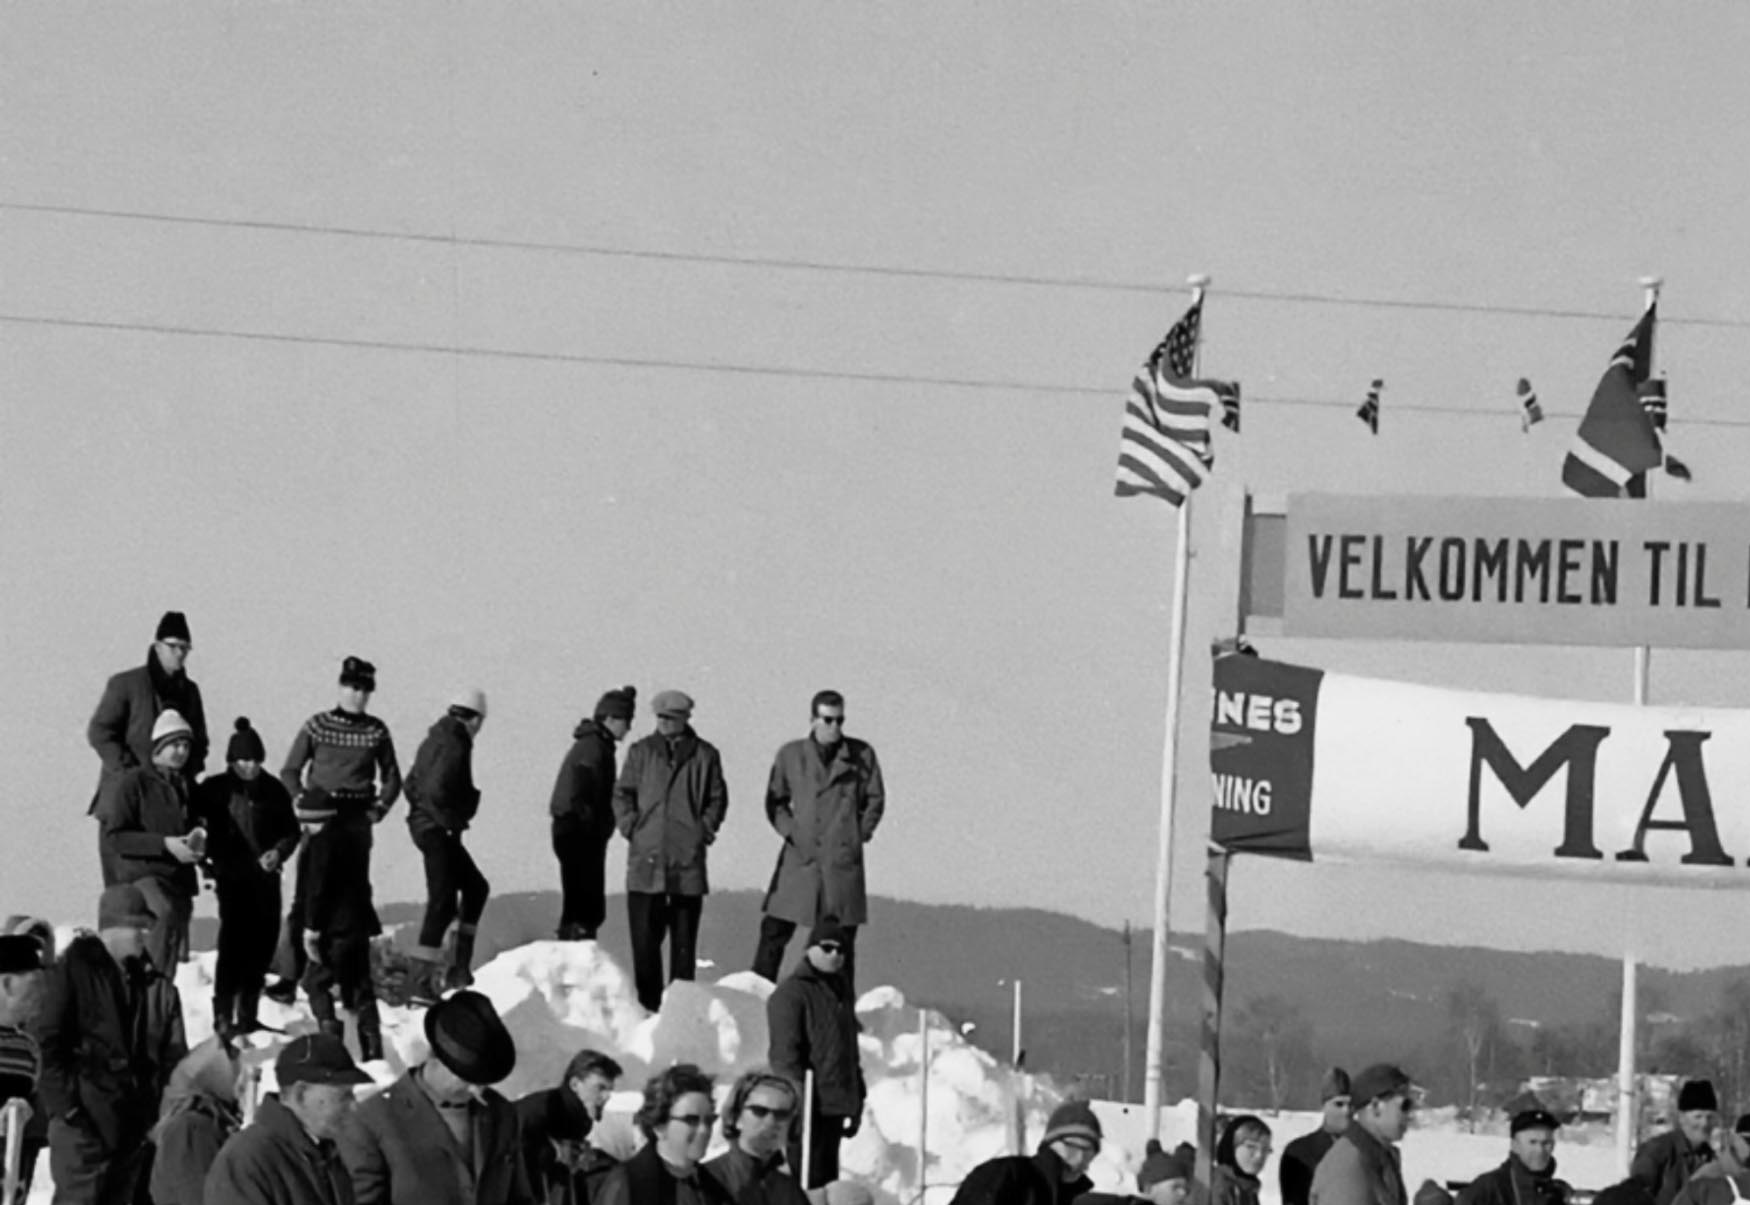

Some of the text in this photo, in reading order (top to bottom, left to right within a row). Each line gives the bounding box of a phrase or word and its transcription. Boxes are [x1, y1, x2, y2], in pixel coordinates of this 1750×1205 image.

[1308, 534, 1619, 606] VELKOMMEN
[1643, 541, 1722, 609] TIL
[1213, 687, 1302, 735] NES
